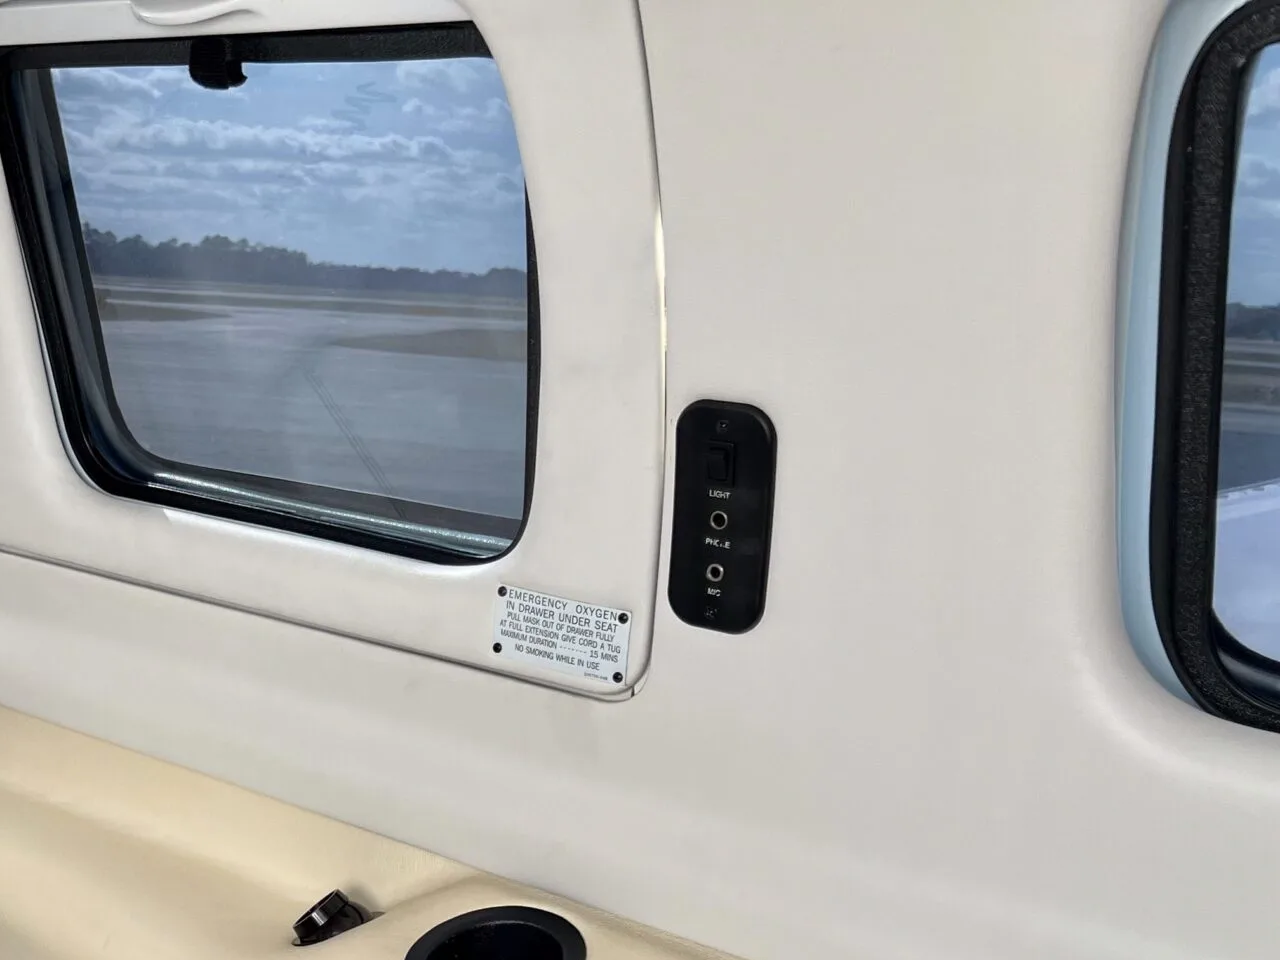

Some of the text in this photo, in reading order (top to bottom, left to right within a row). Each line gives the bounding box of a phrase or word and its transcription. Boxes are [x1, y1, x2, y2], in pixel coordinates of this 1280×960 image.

[708, 489, 731, 500] LIGHT
[506, 600, 618, 634] IN DRAWER UNDER SEAT
[508, 589, 618, 622] EMERGENCY OXYGEN
[500, 620, 621, 654] AT FULL EXTENSION GIVE CORD A TUG
[507, 611, 615, 643] PULL MASK OUT OF DRAWER FULLY
[500, 628, 619, 664] MAXIMUM DURATION 15 MINS
[514, 643, 601, 671] NO SMOKING WHILE IN USE
